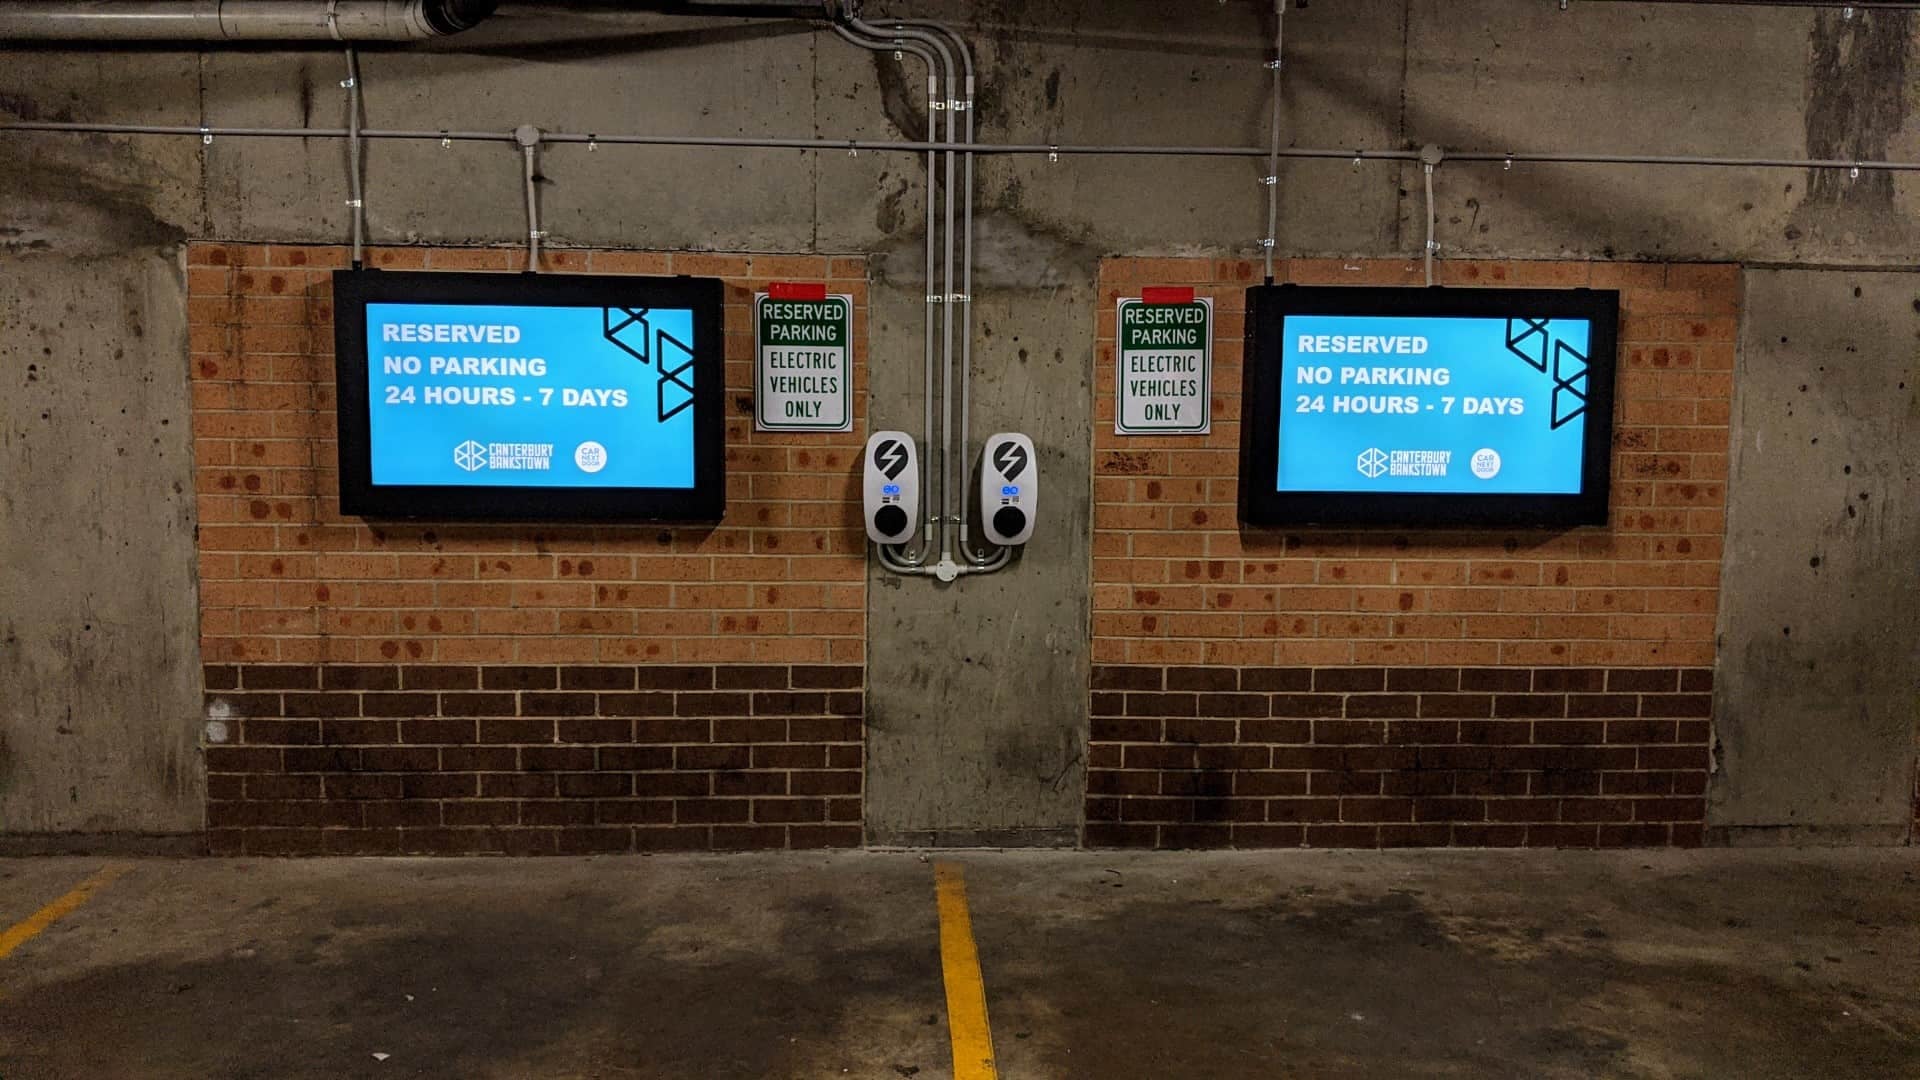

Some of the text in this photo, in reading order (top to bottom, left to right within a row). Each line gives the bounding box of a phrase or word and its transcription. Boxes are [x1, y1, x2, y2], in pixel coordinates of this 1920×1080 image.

[763, 303, 843, 320] RESERVED
[1125, 308, 1204, 324] RESERVED
[382, 323, 521, 344] RESERVED
[770, 324, 837, 341] PARKING
[1132, 329, 1197, 345] PARKING
[1298, 335, 1428, 354] RESERVED
[383, 355, 547, 377] NO PARKING
[770, 352, 836, 369] ELECTRIC
[1131, 356, 1196, 373] ELECTRIC
[770, 376, 837, 394] VEHICLES
[1297, 367, 1450, 386] NO PARKING
[384, 386, 415, 405] 24
[424, 386, 516, 406] HOURS
[539, 388, 553, 407] 7
[562, 388, 628, 407] DAYS
[1130, 380, 1196, 397] VEHICLES
[785, 400, 822, 417] ONLY
[1144, 404, 1181, 421] ONLY
[1296, 396, 1325, 413] 24
[1333, 396, 1419, 414] HOURS
[1442, 397, 1454, 415] 7
[1463, 397, 1524, 415] DAYS
[489, 443, 553, 457] CANTERBURY
[1390, 451, 1452, 463] CANTERBURY
[489, 457, 549, 470] BANKSTOWN
[1390, 464, 1447, 476] BANKSTOWN
